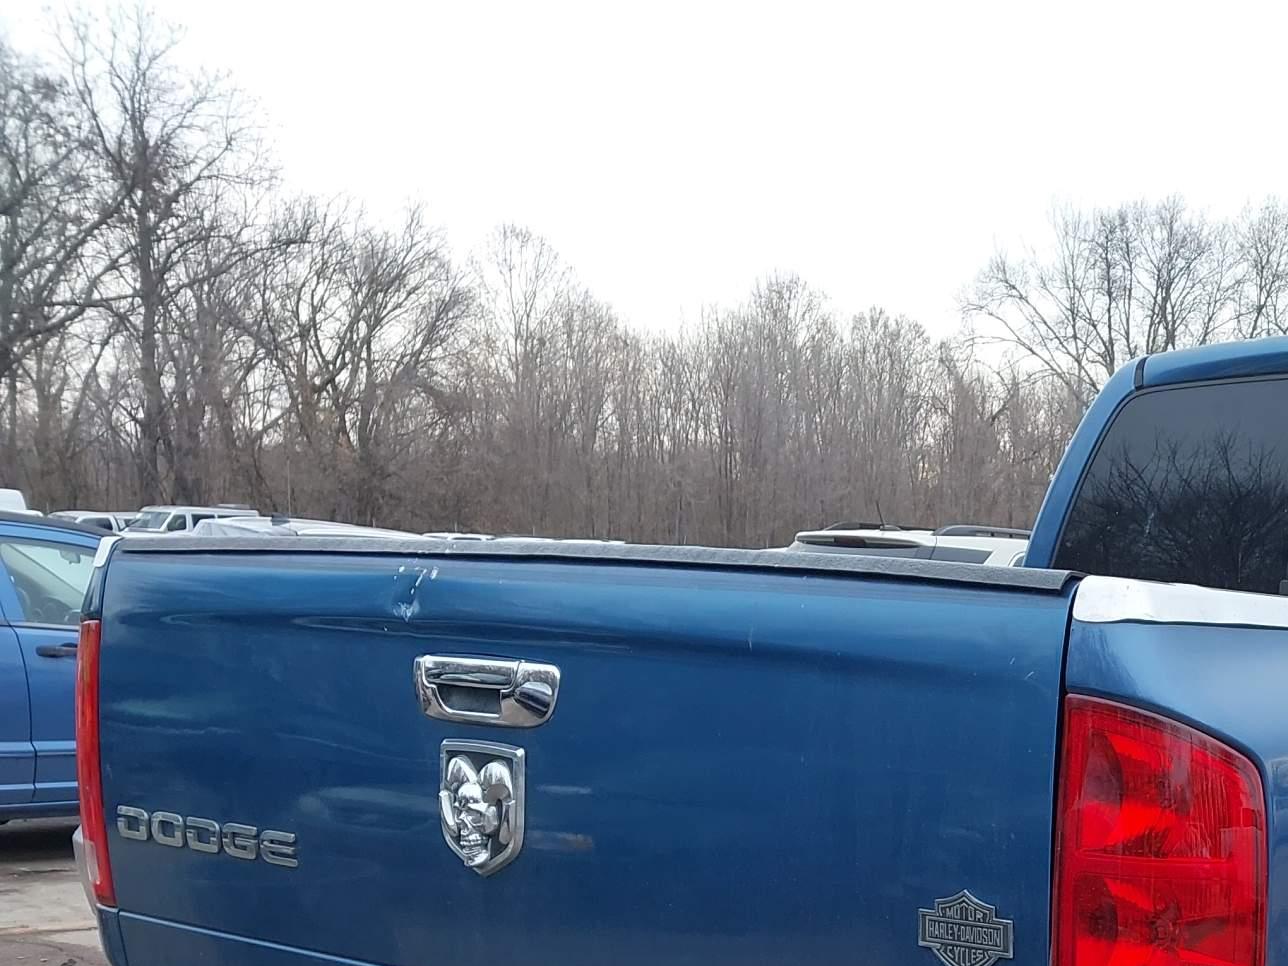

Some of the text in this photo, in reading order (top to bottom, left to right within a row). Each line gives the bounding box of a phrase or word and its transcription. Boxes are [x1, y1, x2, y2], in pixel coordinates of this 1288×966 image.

[117, 805, 298, 867] DODGE
[945, 903, 985, 922] MOTOR
[928, 921, 1001, 947] HARLEY-DAVIDSON
